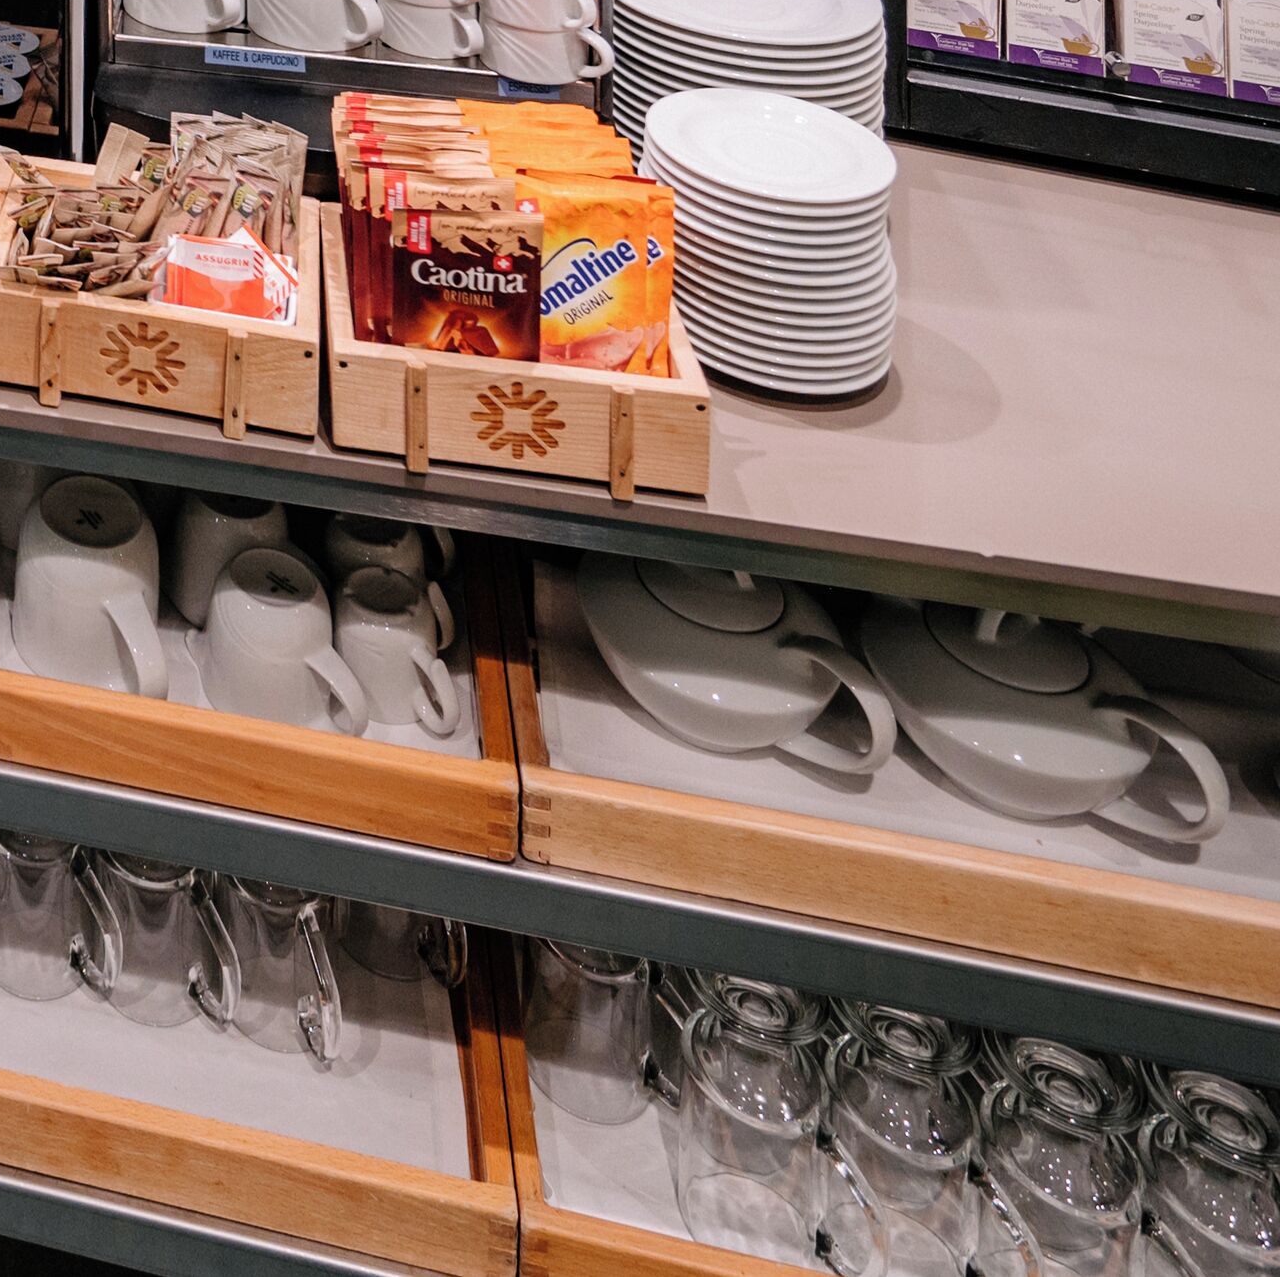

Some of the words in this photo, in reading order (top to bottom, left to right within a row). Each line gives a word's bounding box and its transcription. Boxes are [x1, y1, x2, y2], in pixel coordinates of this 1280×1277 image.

[212, 49, 240, 62] KAFFEE
[243, 52, 249, 63] &
[251, 53, 299, 67] CAPPUCCINO
[195, 253, 250, 268] ASSUGRIN
[411, 258, 528, 294] Caotina
[540, 241, 637, 316] omaltine
[443, 289, 495, 309] ORIGINAL
